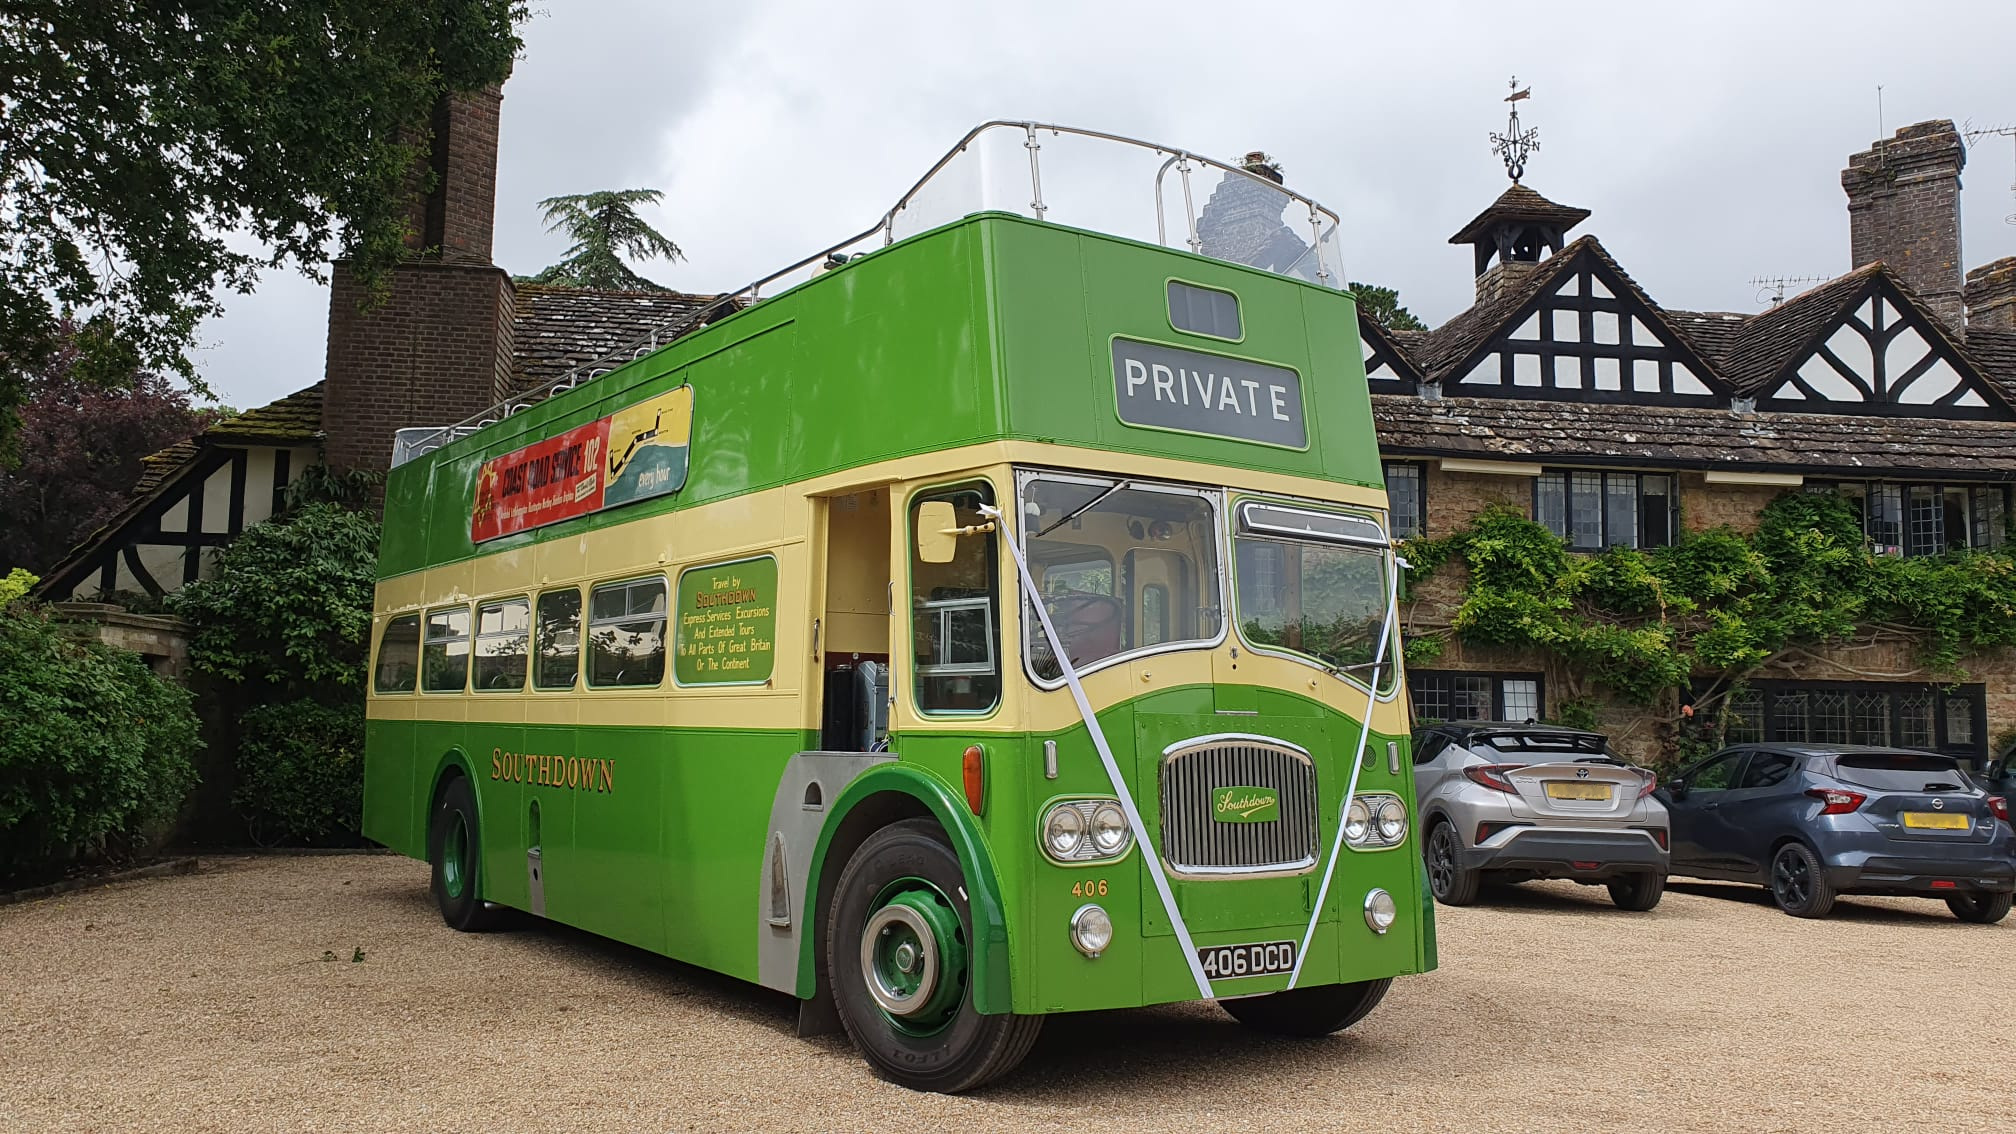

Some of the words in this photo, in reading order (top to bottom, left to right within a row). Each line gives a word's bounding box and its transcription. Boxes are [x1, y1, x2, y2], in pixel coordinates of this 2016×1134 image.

[1125, 358, 1290, 422] PRIVATE
[583, 436, 600, 474] 102
[639, 470, 655, 489] every
[656, 464, 671, 482] hour
[712, 576, 729, 590] Travel
[732, 576, 741, 589] by
[696, 588, 756, 609] SOUTHDOWN
[683, 612, 705, 627] Express
[706, 610, 731, 623] Services
[735, 606, 770, 620] Excursions
[694, 627, 706, 639] And
[709, 624, 735, 638] Extended
[739, 622, 755, 636] Tours
[680, 643, 687, 657] To
[688, 643, 697, 655] All
[698, 642, 715, 655] Parts
[729, 639, 746, 653] Great
[750, 638, 771, 651] Britain
[697, 659, 705, 671] Or
[708, 657, 719, 670] The
[722, 657, 750, 670] Continent
[1217, 790, 1275, 814] Southdown
[1071, 879, 1108, 897] 406
[1203, 948, 1247, 977] 406
[1251, 944, 1292, 972] DCD
